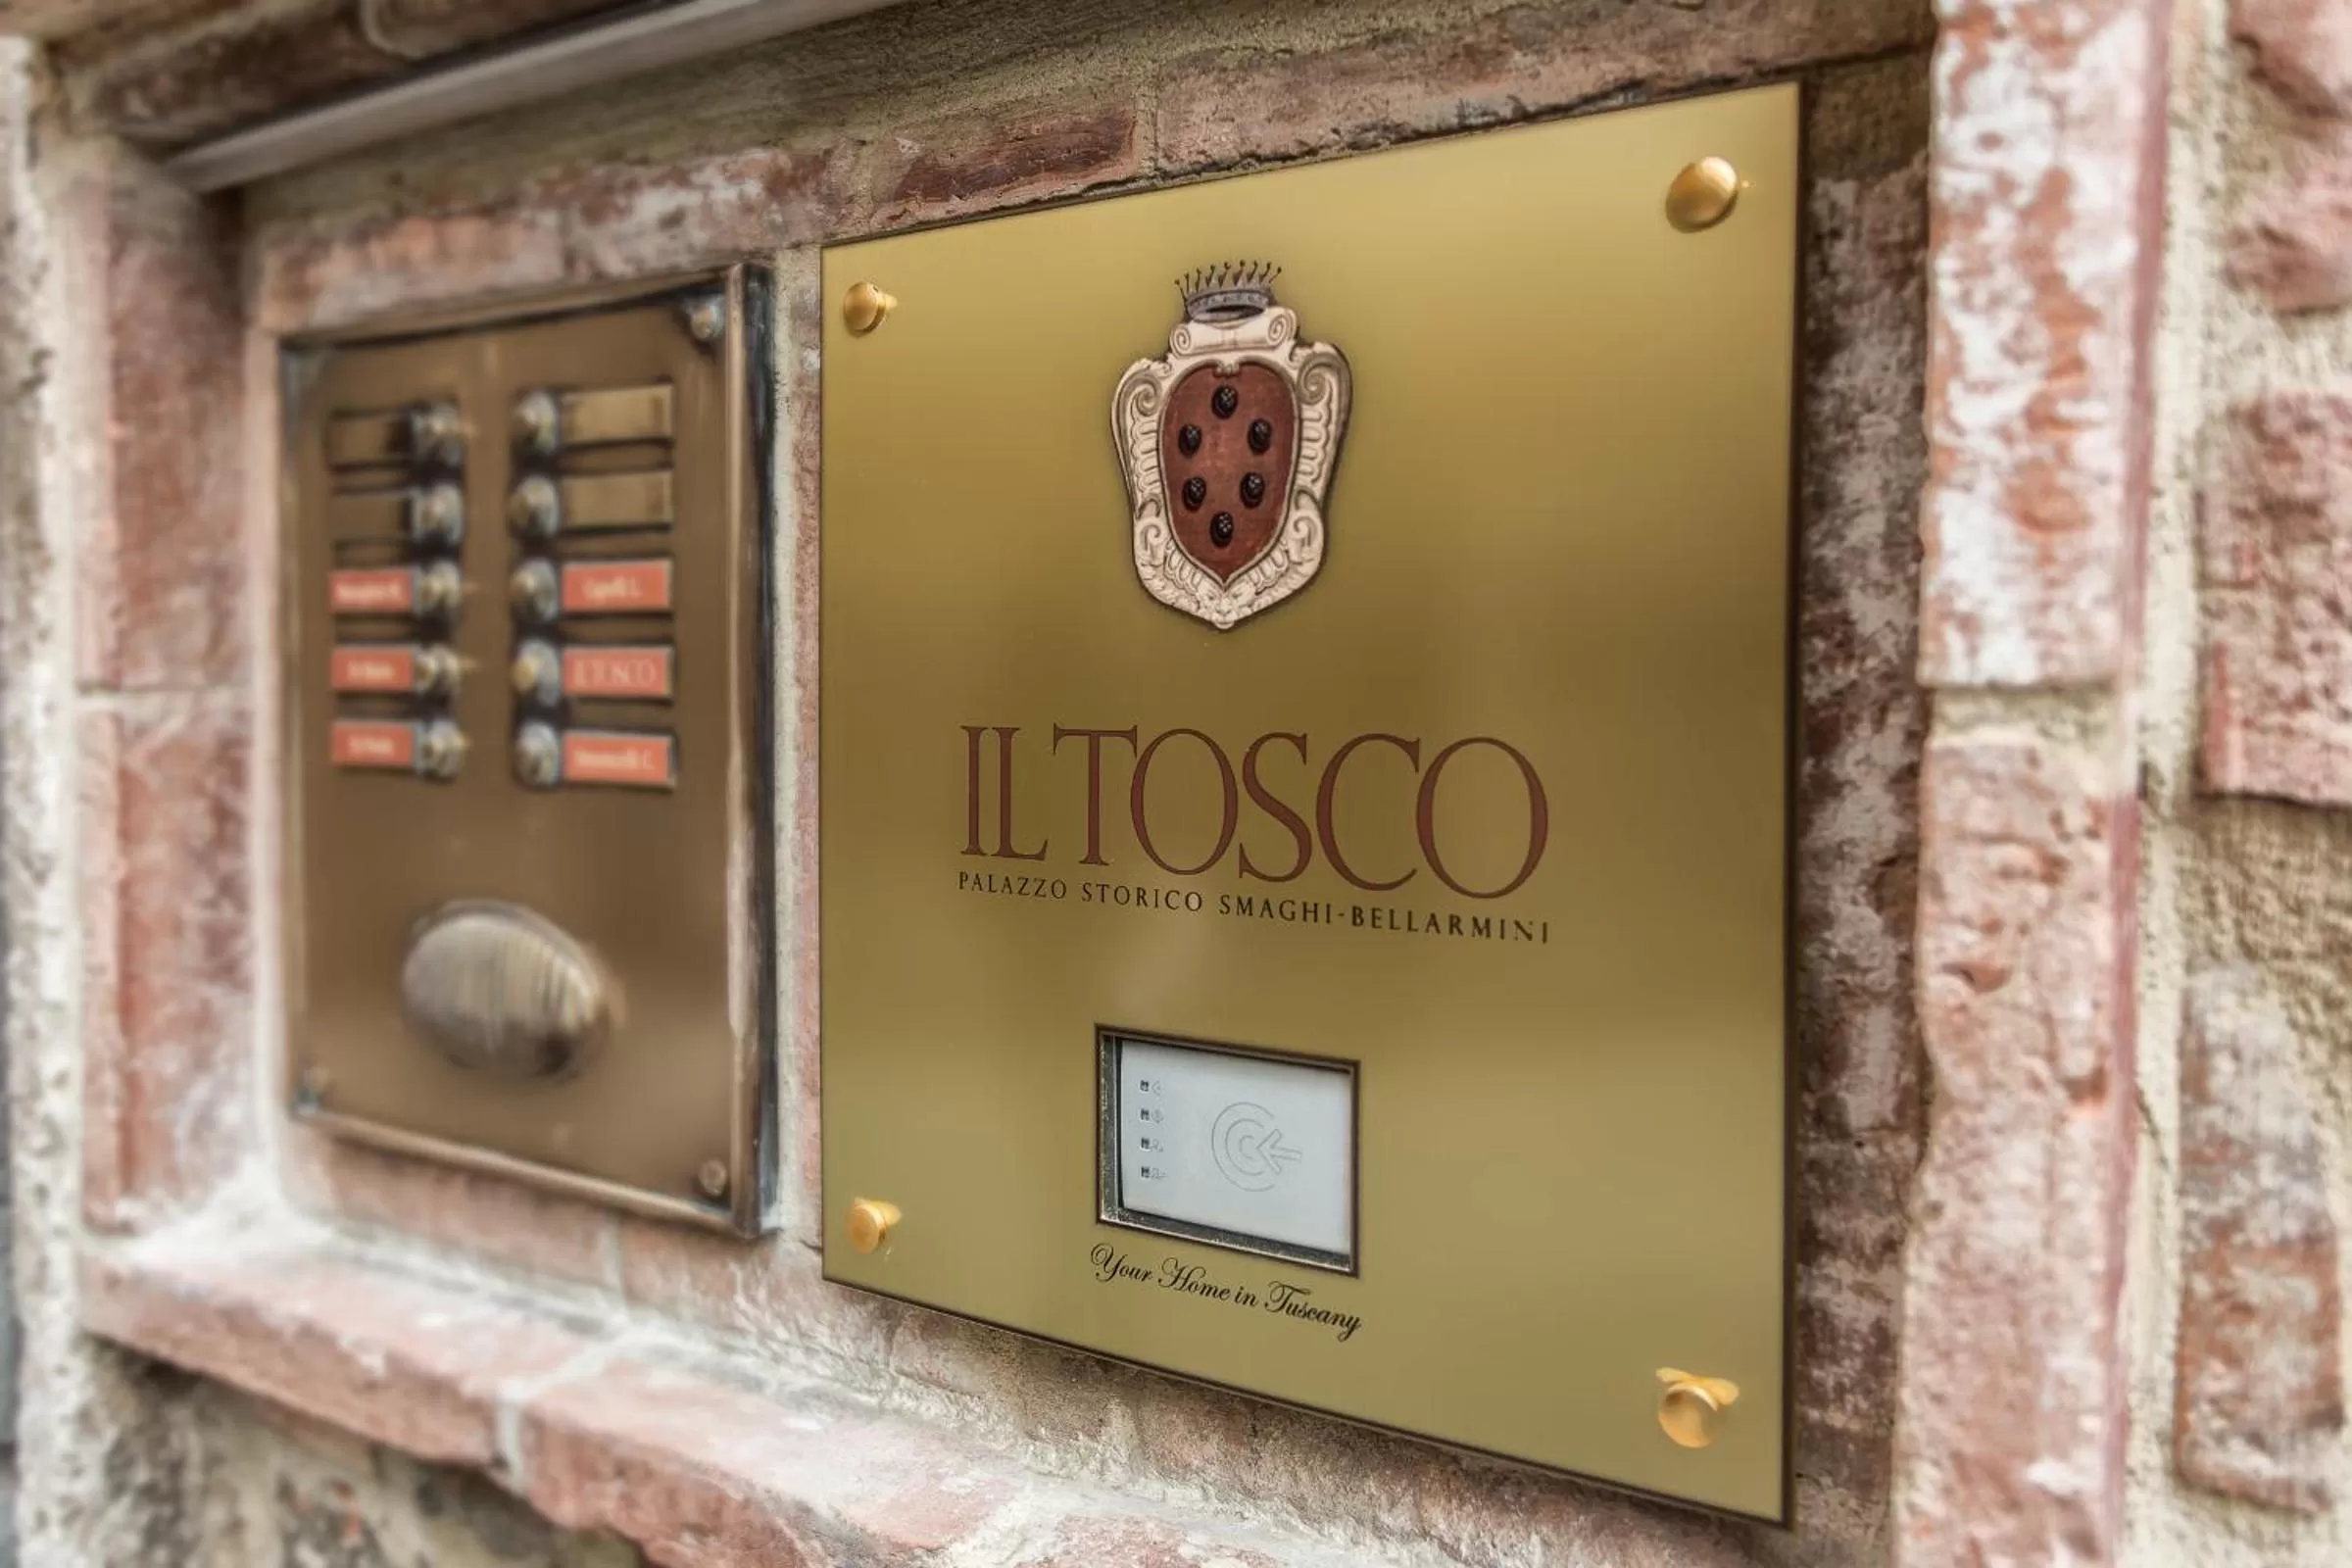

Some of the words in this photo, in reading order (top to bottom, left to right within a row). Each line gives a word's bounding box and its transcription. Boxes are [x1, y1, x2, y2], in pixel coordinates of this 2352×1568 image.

[960, 725, 1049, 860] IL
[1053, 722, 1548, 900] TOSCO
[958, 870, 1067, 900] PALAZZO
[1082, 882, 1203, 912] STORICO
[1218, 895, 1549, 945] SMAGHI-BELLARMINI
[1090, 1243, 1152, 1283] Your
[1157, 1257, 1232, 1300] Home
[1235, 1285, 1258, 1307] in
[1264, 1280, 1362, 1343] Tuscany
